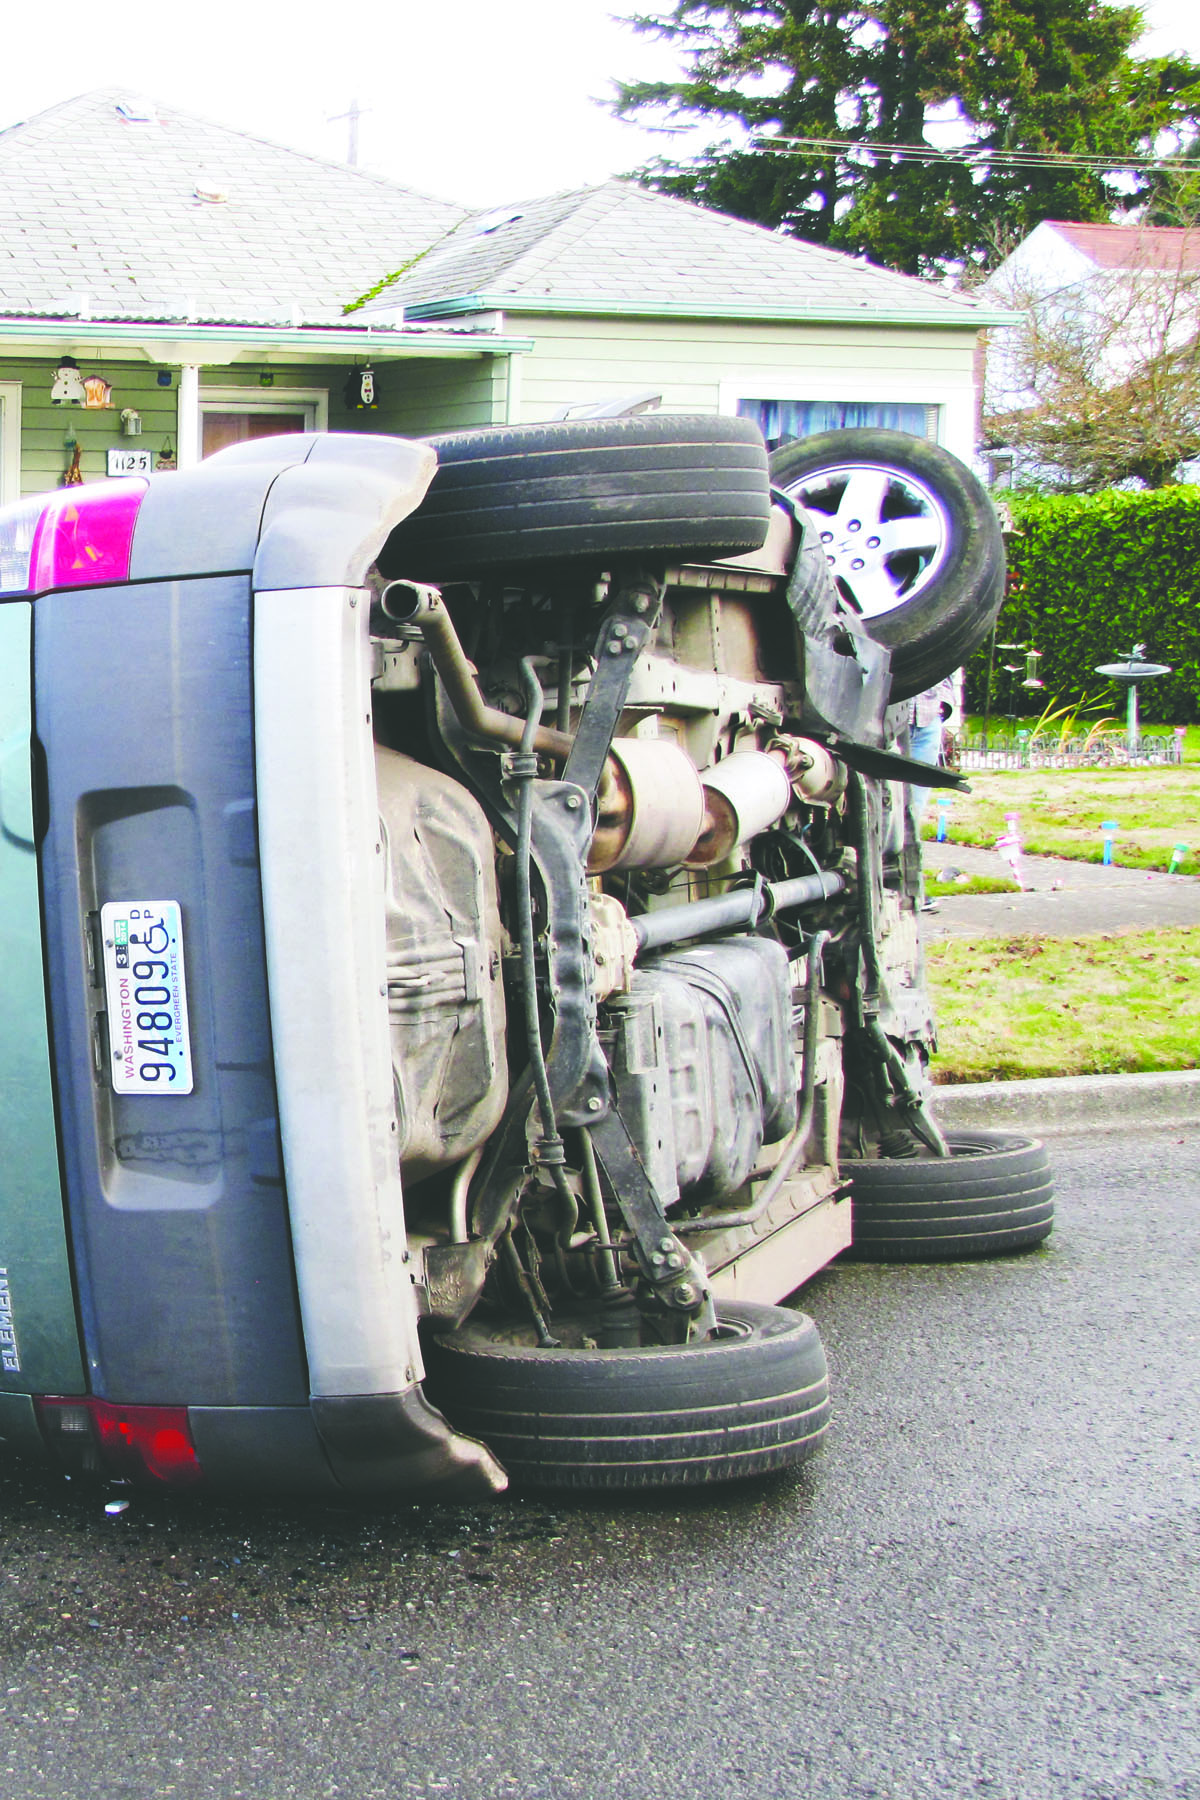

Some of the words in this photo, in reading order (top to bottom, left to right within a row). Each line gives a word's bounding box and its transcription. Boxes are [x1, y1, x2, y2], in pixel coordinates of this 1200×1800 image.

[113, 456, 147, 471] 1125
[116, 953, 127, 965] 3
[170, 952, 178, 982] STATE
[119, 978, 135, 1079] WASHINGTON
[132, 960, 177, 1082] 94809
[171, 985, 182, 1043] EVERGREEN
